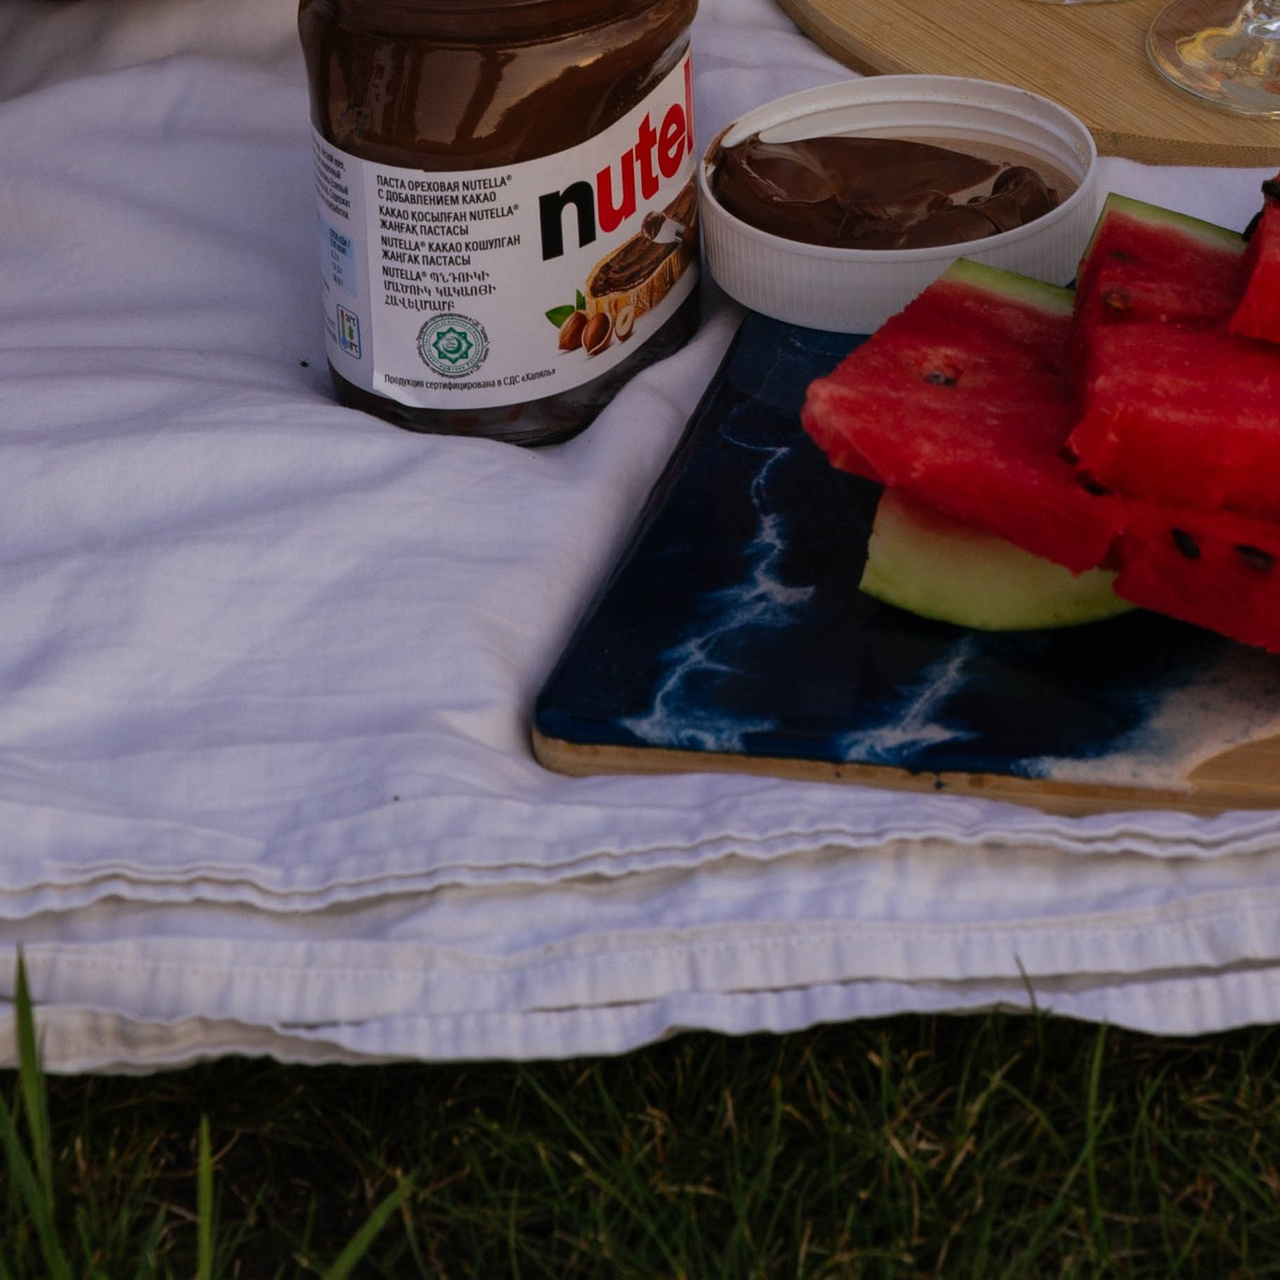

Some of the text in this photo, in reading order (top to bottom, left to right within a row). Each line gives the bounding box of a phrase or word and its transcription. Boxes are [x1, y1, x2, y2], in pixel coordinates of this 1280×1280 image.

[377, 175, 406, 190] ПАСТА
[408, 180, 460, 192] ОРЕХОВАЯ
[378, 188, 496, 206] С ДОБАВЛЕНИЕМ КАКАО
[379, 205, 409, 221] КАКАО
[420, 225, 469, 236] ПАСТАСЫ
[428, 241, 463, 253] КАКАО
[465, 235, 521, 252] КОШУЛГАН
[422, 255, 471, 266] ПАСТАСЫ
[384, 374, 425, 389] Продукция
[426, 380, 496, 391] сертифицирована
[503, 374, 520, 388] СДС
[521, 367, 557, 383] «Халяль»
